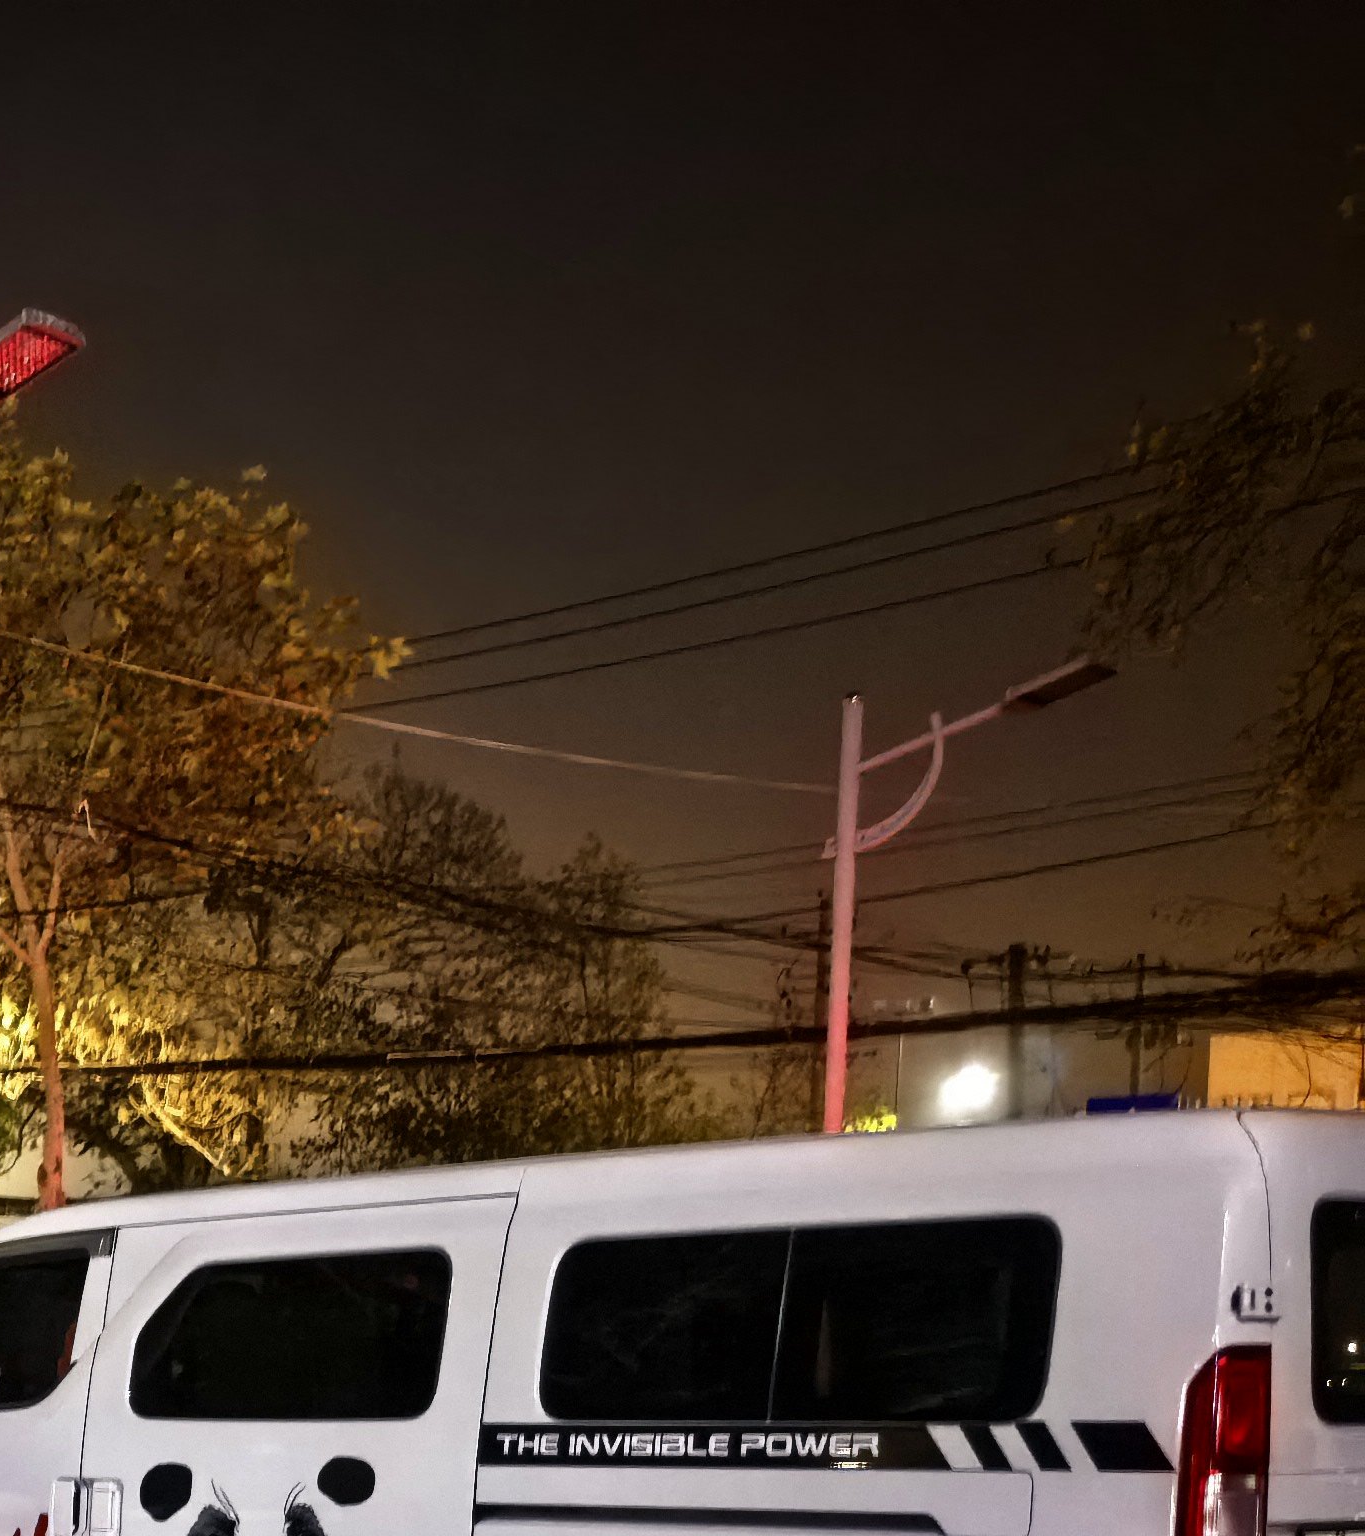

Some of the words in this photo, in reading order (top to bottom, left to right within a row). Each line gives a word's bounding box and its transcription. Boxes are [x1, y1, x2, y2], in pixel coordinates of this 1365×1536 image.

[496, 1432, 560, 1457] THE
[569, 1432, 730, 1457] INVISIBLE
[741, 1432, 879, 1458] POWER
